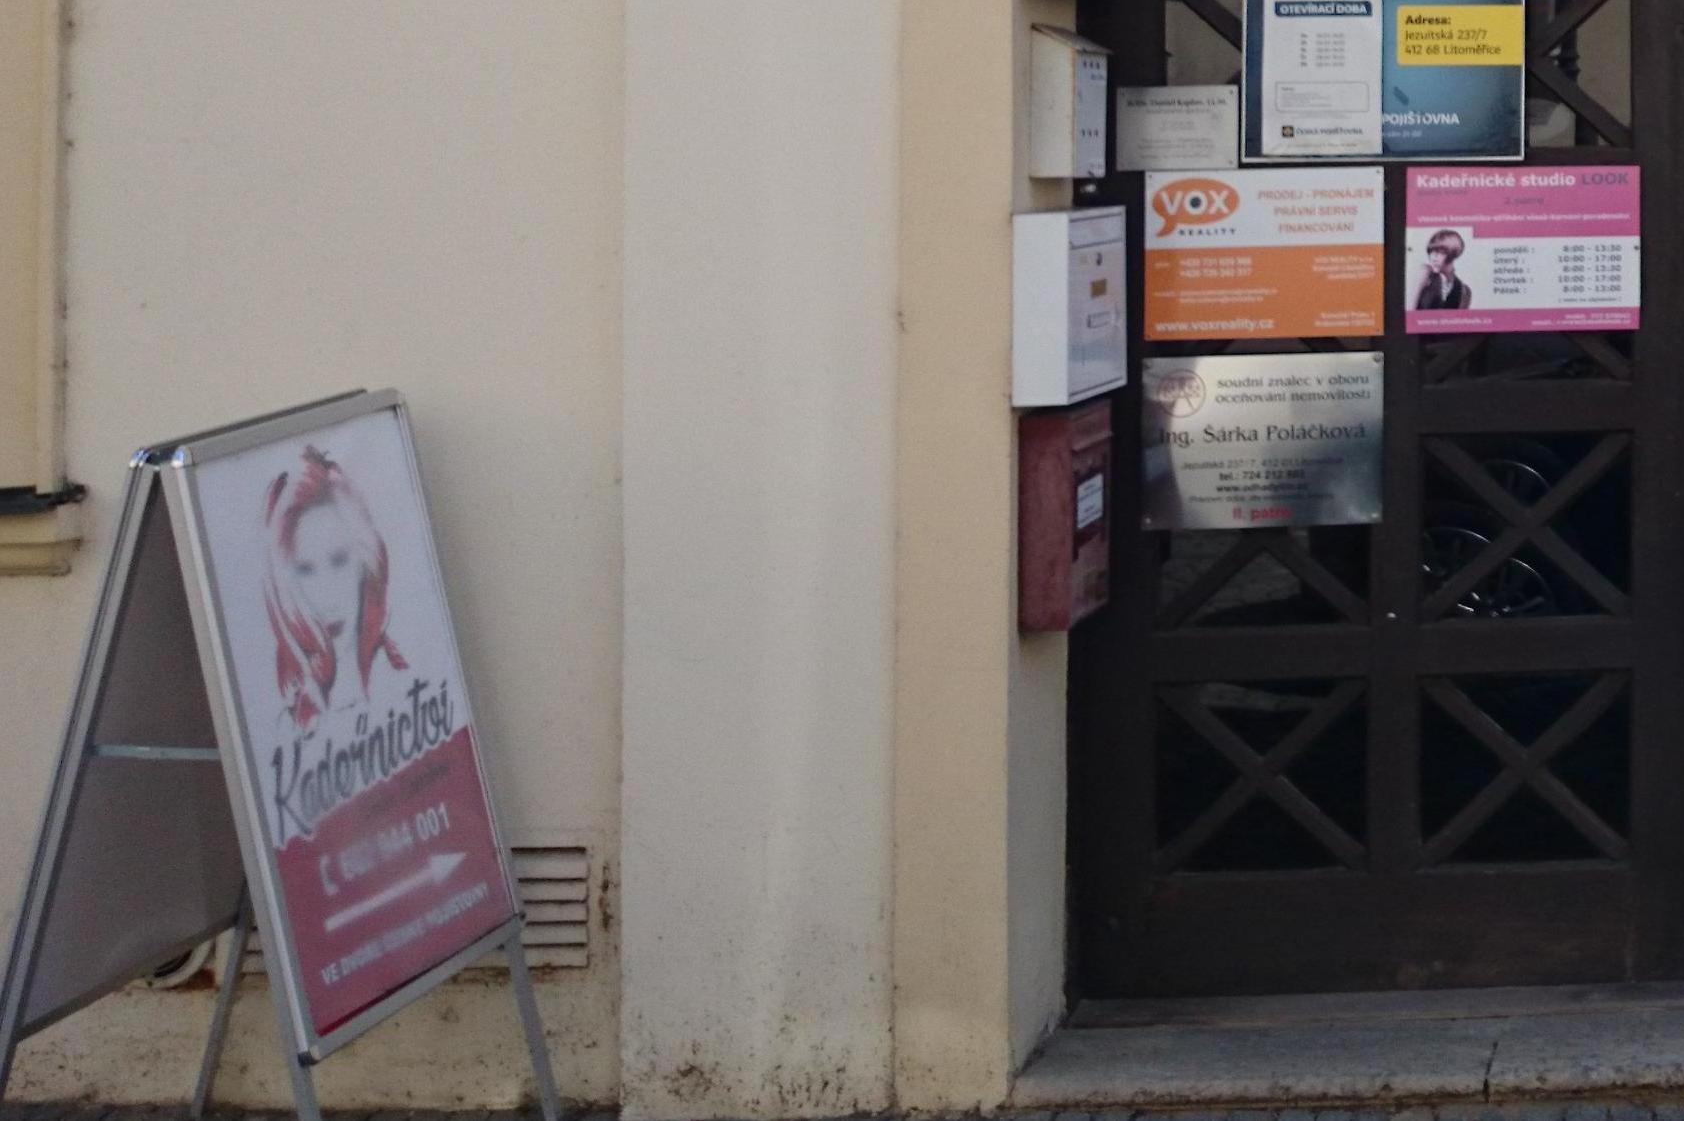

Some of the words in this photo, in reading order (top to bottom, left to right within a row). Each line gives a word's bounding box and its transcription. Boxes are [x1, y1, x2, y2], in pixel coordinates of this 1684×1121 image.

[1280, 2, 1334, 15] OTEVÍRACÍ
[1337, 4, 1368, 15] DOBA
[1405, 14, 1452, 26] Adresa:
[1405, 29, 1453, 41] Jezuitská
[1457, 29, 1488, 41] 237/7
[1405, 45, 1423, 55] 412
[1443, 43, 1502, 56] Litoměřice
[1416, 172, 1516, 188] Kadeřnické
[1520, 173, 1577, 188] studio
[1581, 172, 1630, 186] LOOK
[1258, 190, 1303, 201] PRODEJ
[1313, 187, 1375, 200] PRONÁJEM
[1160, 189, 1231, 217] VOX
[1318, 205, 1359, 216] SERVIS
[1178, 227, 1237, 237] REALITY
[1156, 317, 1275, 333] www.voxreality.cz
[1217, 376, 1264, 389] soudní
[1268, 375, 1309, 387] znalec
[1316, 379, 1324, 387] v
[1328, 374, 1370, 386] oboru
[1159, 429, 1194, 449] Ing.
[1203, 424, 1259, 443] Šárka
[1267, 422, 1366, 442] Poláčková
[416, 801, 451, 842] 001
